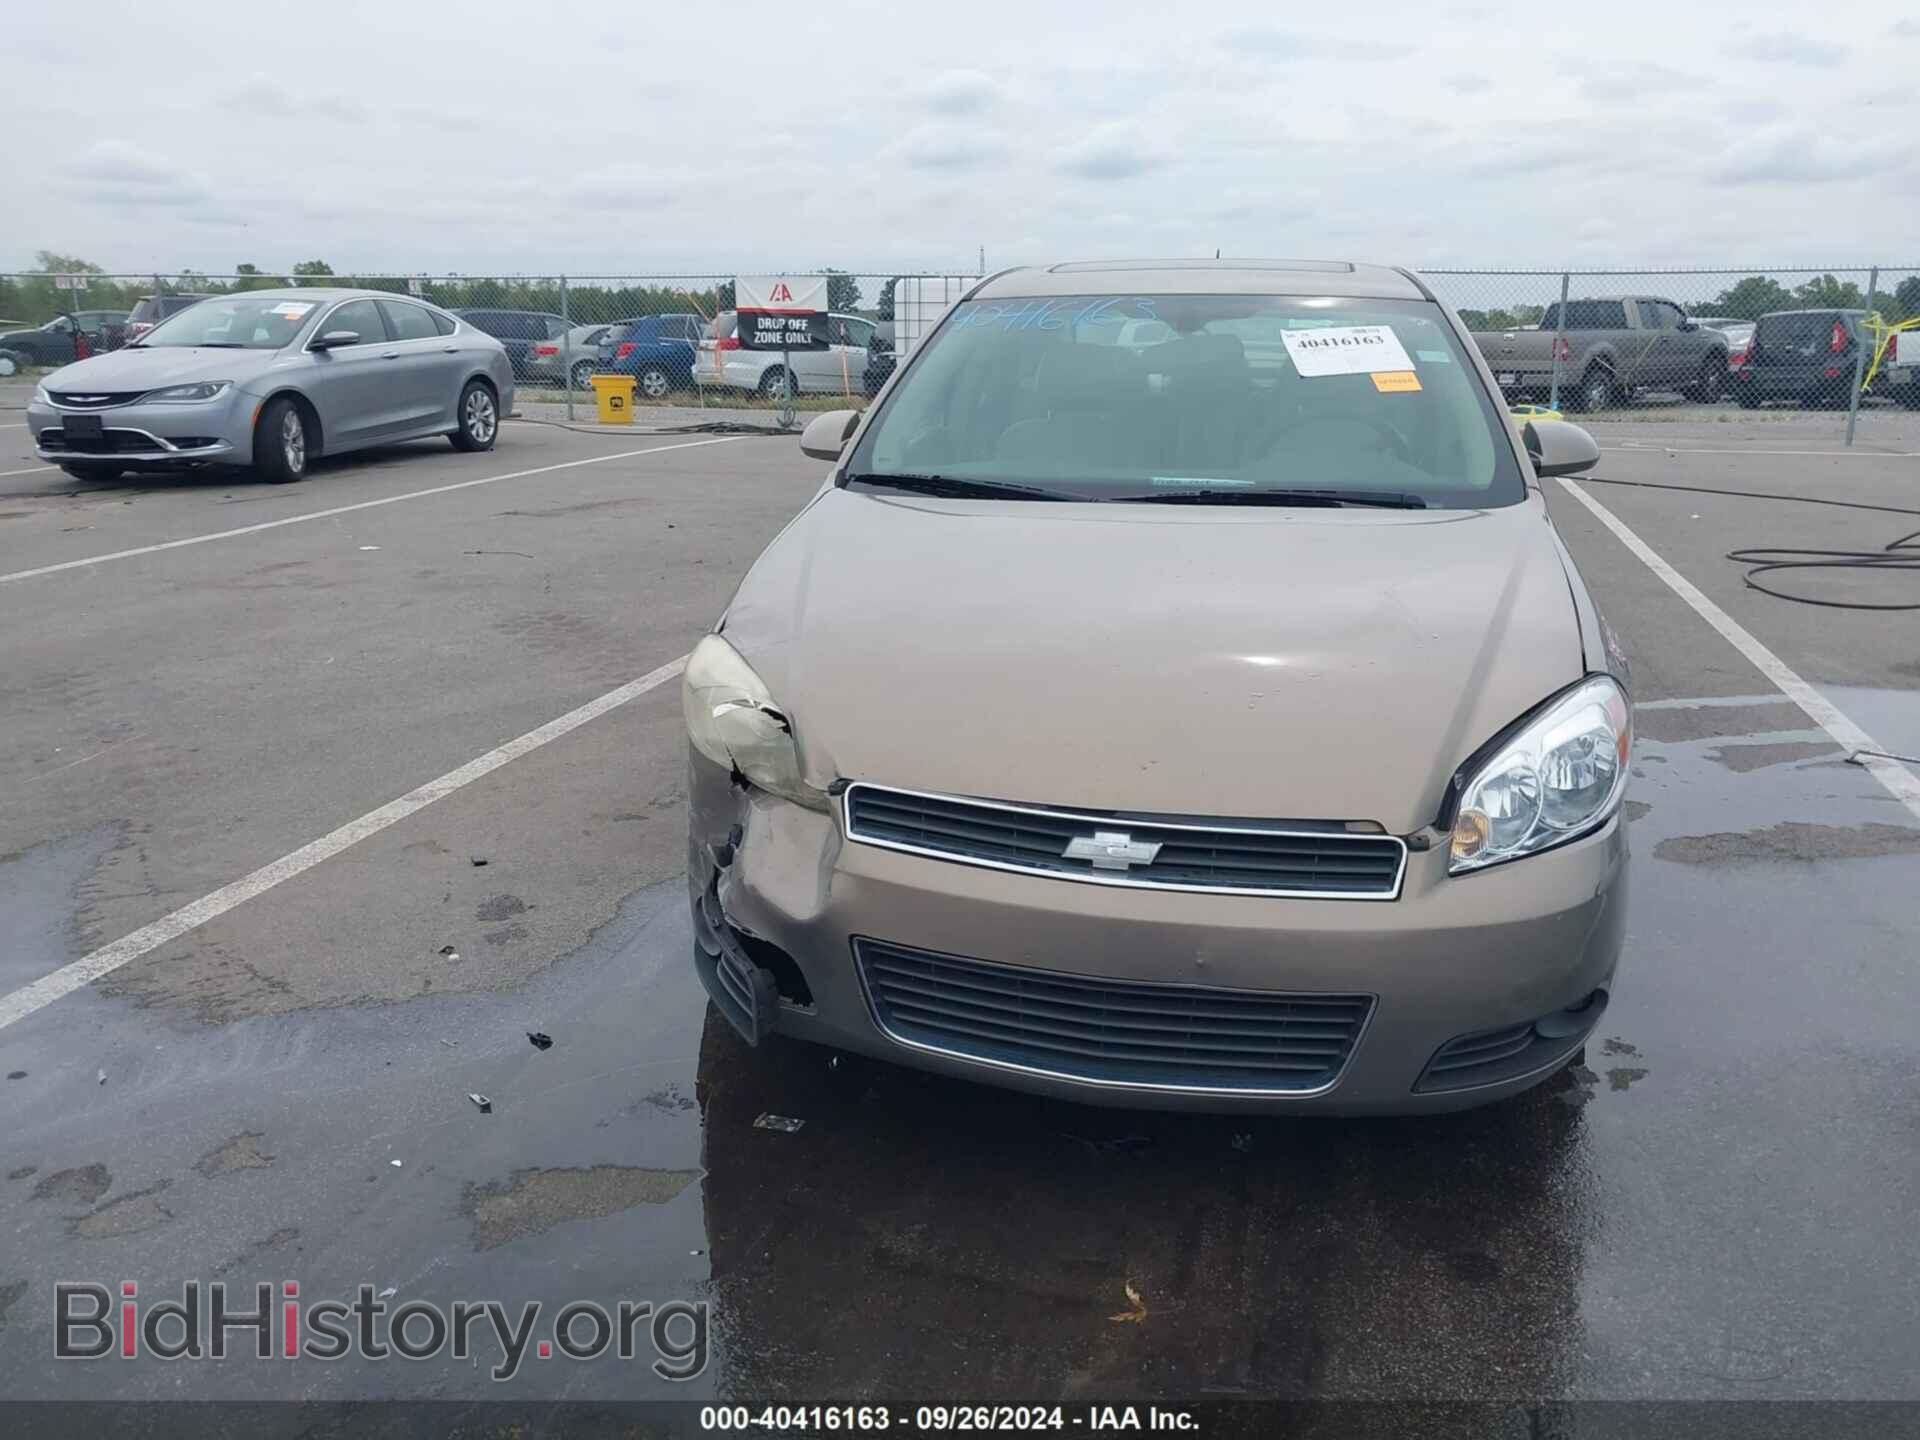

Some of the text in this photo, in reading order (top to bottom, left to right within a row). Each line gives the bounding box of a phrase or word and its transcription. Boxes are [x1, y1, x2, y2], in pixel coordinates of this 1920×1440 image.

[757, 318, 809, 331] DROP OFF
[754, 331, 812, 344] ZONE ONLY
[1298, 335, 1384, 349] 40416163
